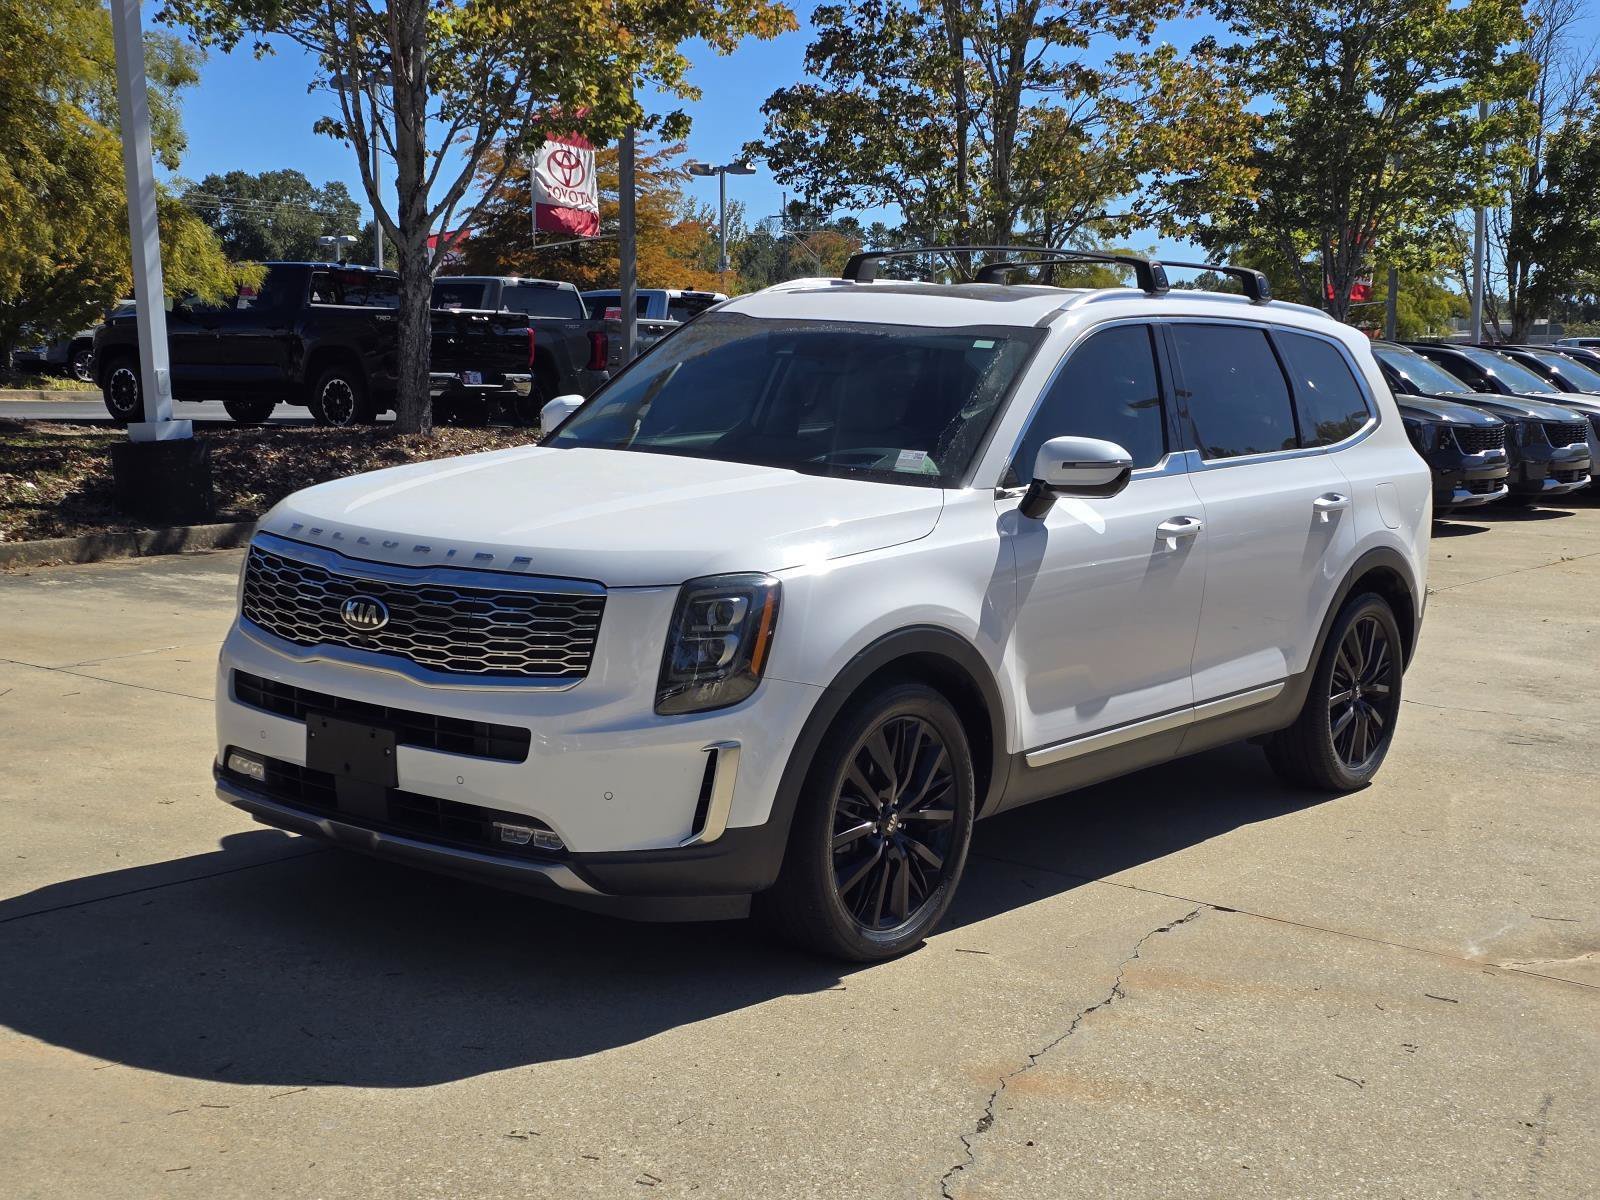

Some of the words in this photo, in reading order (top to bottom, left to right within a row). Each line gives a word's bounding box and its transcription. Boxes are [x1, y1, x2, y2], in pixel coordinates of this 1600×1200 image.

[544, 184, 597, 208] TOYOTA
[291, 522, 533, 565] TELLURIDE
[345, 601, 379, 625] KIA
